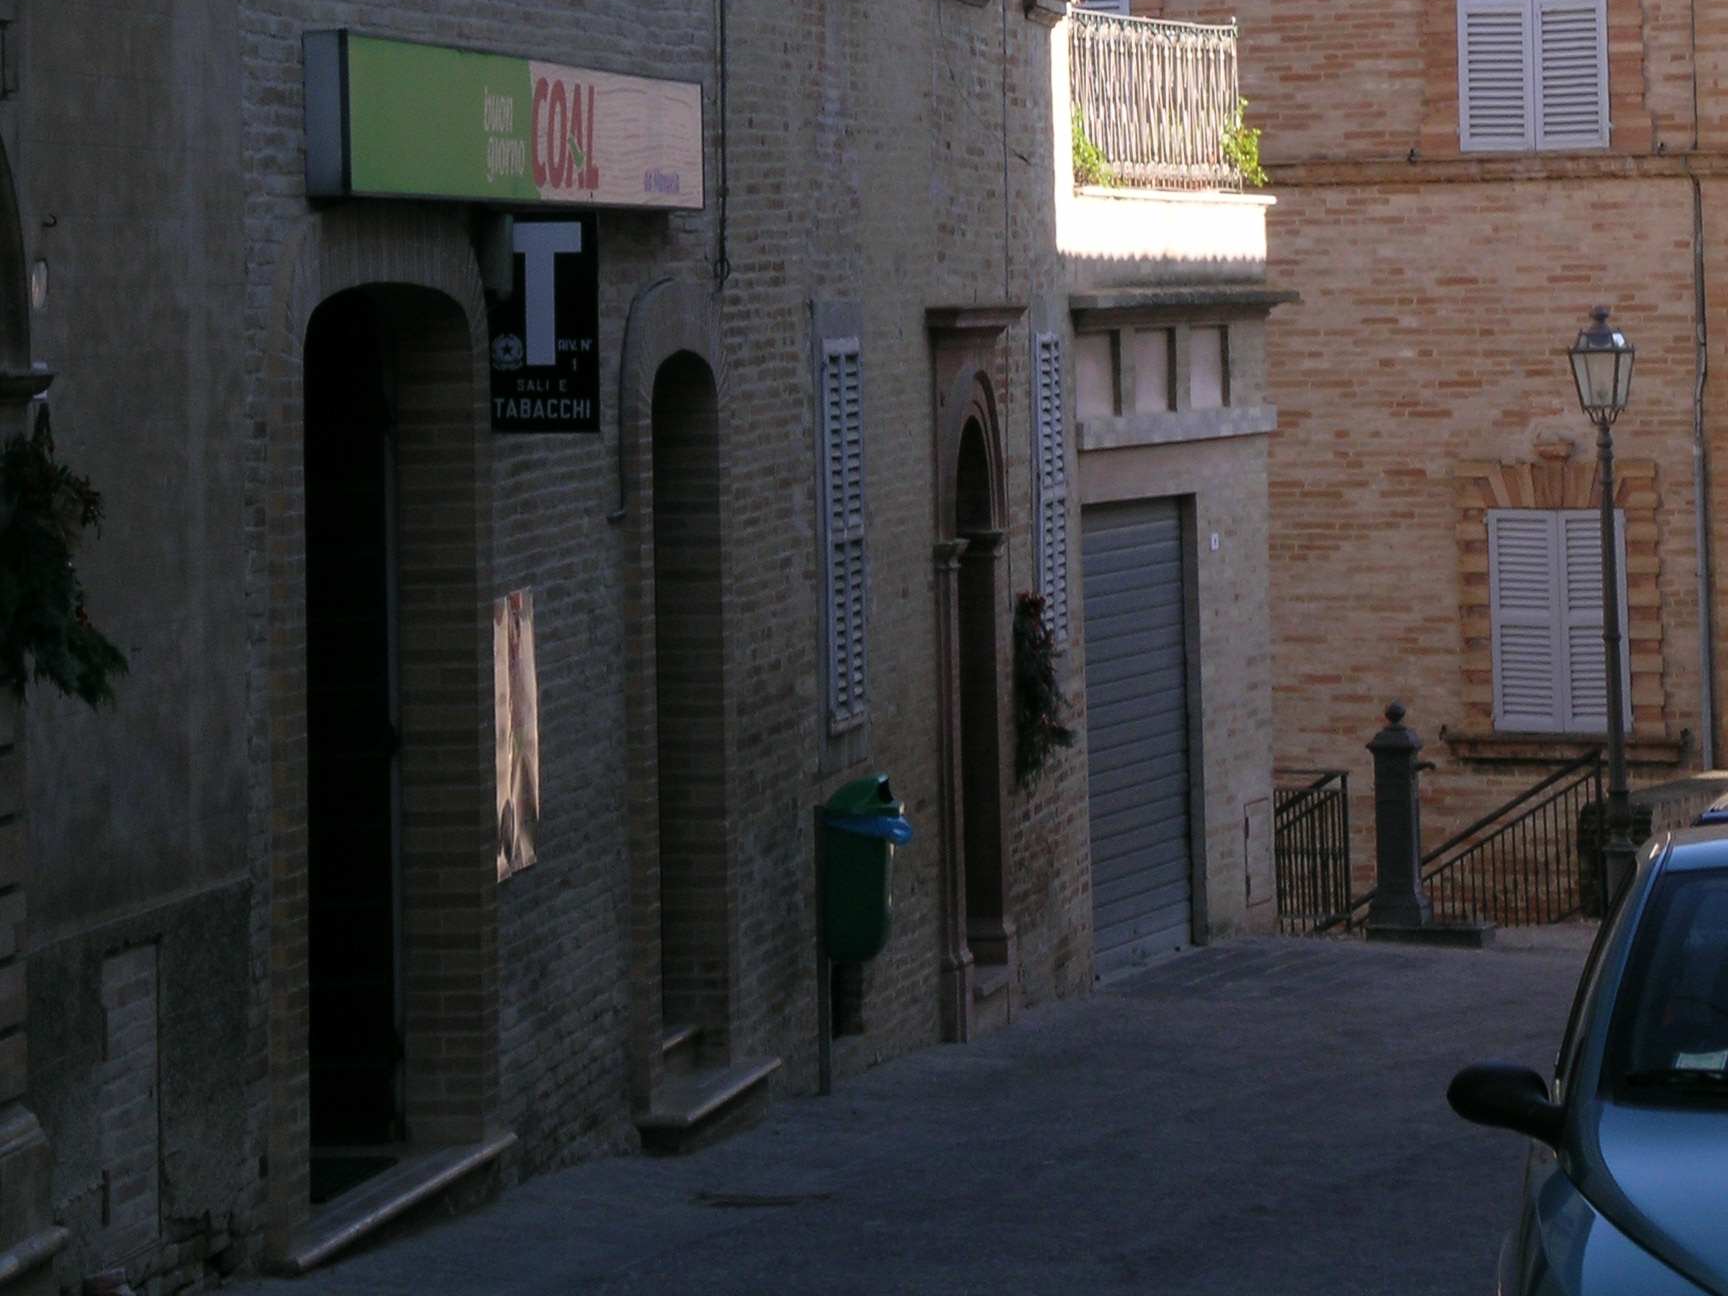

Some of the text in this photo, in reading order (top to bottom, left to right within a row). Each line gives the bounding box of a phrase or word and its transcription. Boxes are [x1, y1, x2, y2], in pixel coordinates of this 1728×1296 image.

[483, 86, 513, 131] buon
[533, 77, 598, 189] COAL
[487, 137, 525, 184] giorno
[512, 221, 582, 366] T
[517, 378, 567, 392] SALI E
[494, 398, 590, 419] TABACCHI
